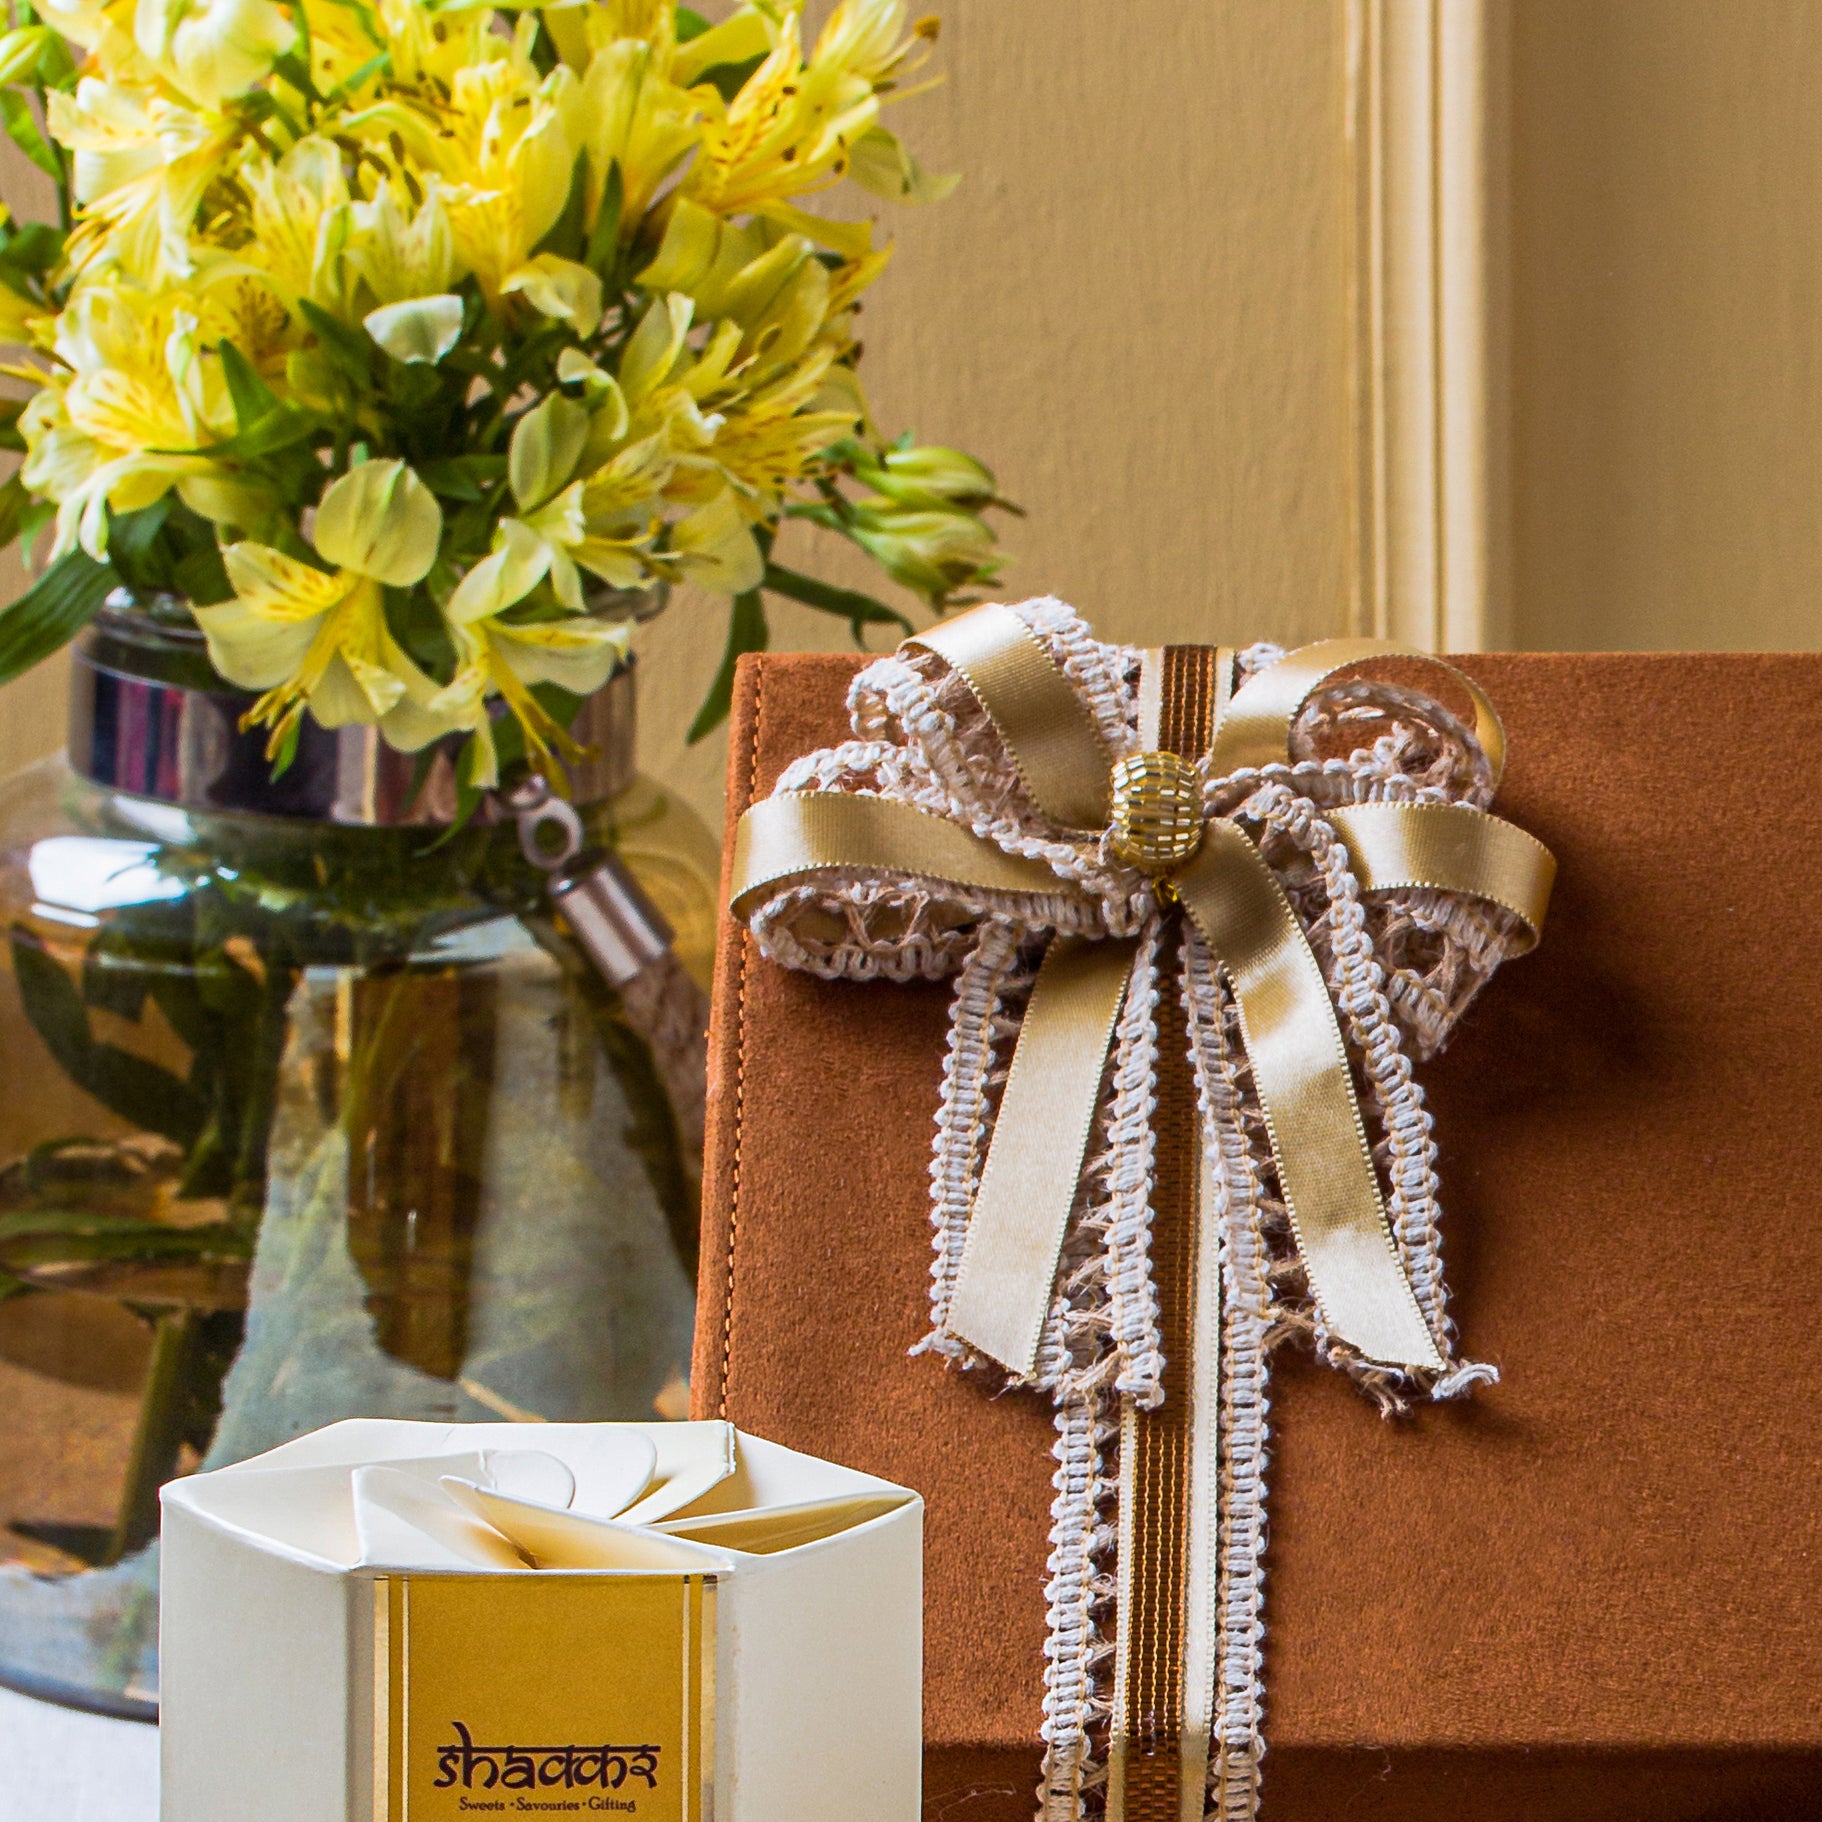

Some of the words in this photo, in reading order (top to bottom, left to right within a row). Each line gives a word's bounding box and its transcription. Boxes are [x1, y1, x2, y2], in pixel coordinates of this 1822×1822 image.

[459, 1797, 505, 1811] Sweets
[516, 1797, 580, 1811] Savouries
[588, 1796, 636, 1813] Gifting
